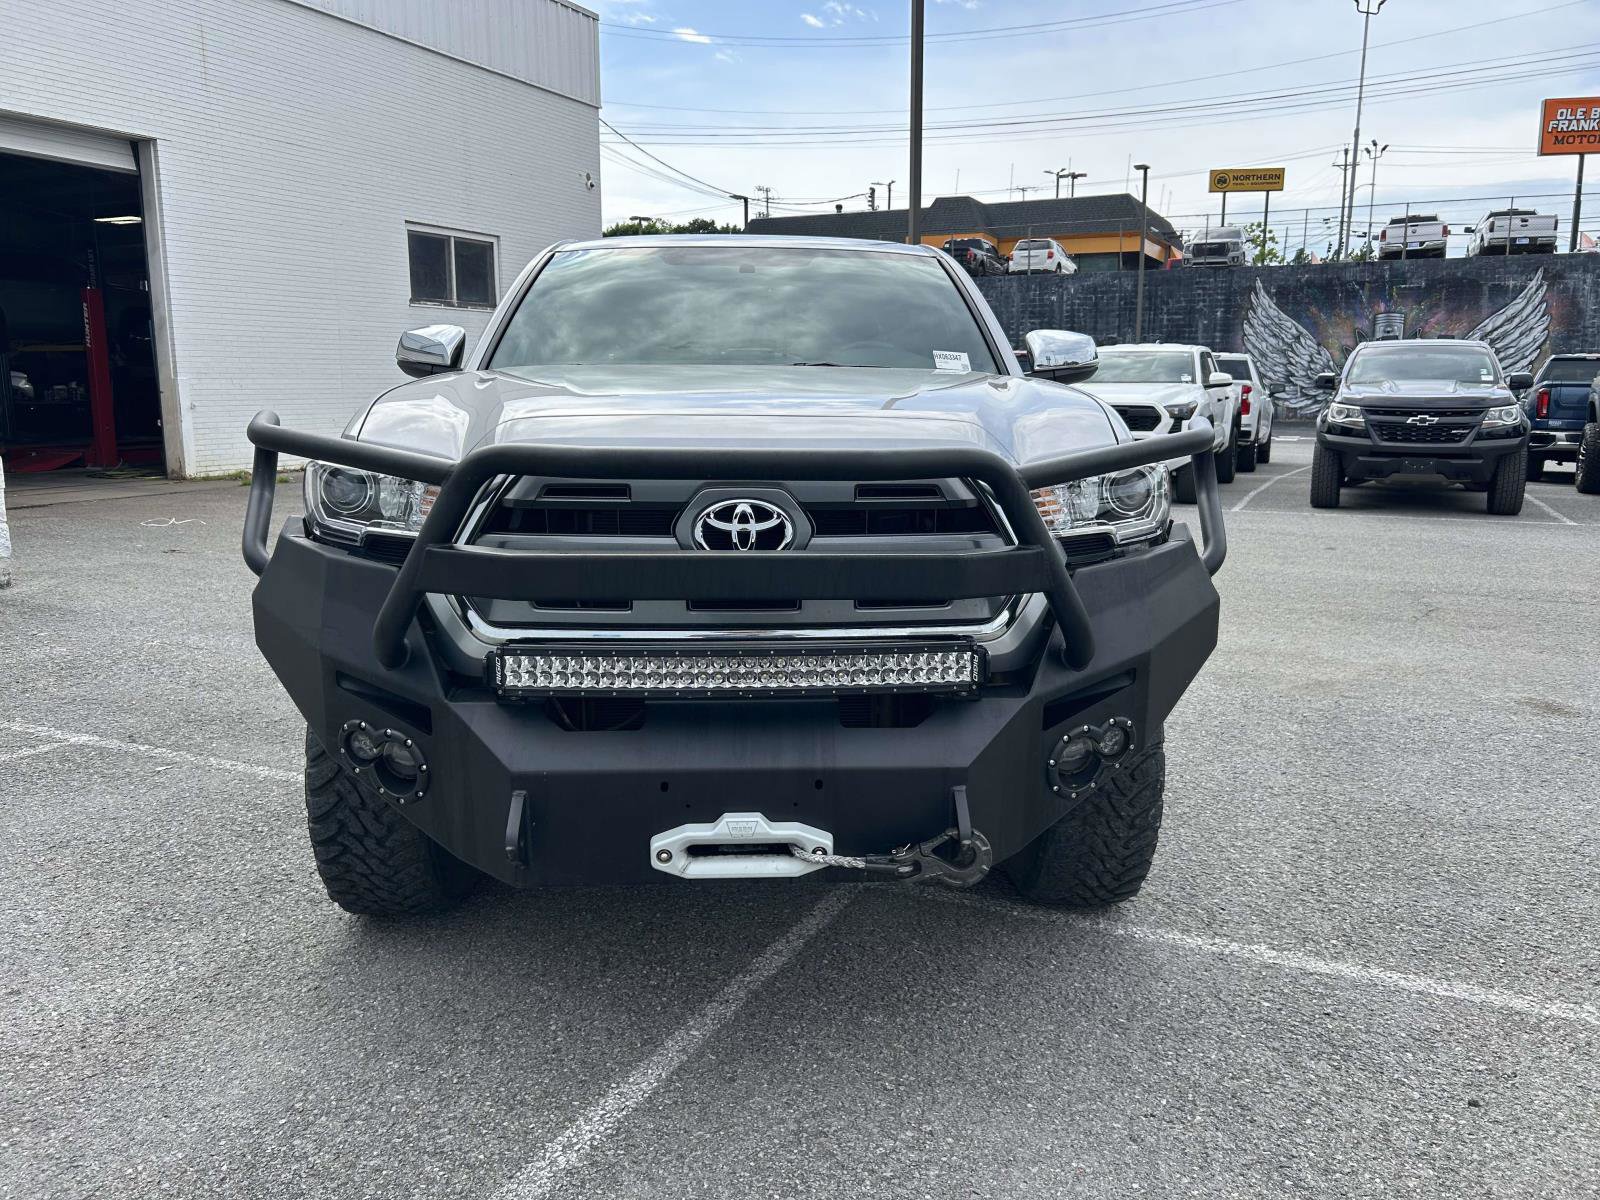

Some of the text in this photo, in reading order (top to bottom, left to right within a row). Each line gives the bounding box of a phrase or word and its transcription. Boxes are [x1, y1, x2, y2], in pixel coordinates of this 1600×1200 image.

[1556, 108, 1586, 120] OLE
[1232, 174, 1280, 182] NORTHERN
[82, 302, 92, 348] HUNTER
